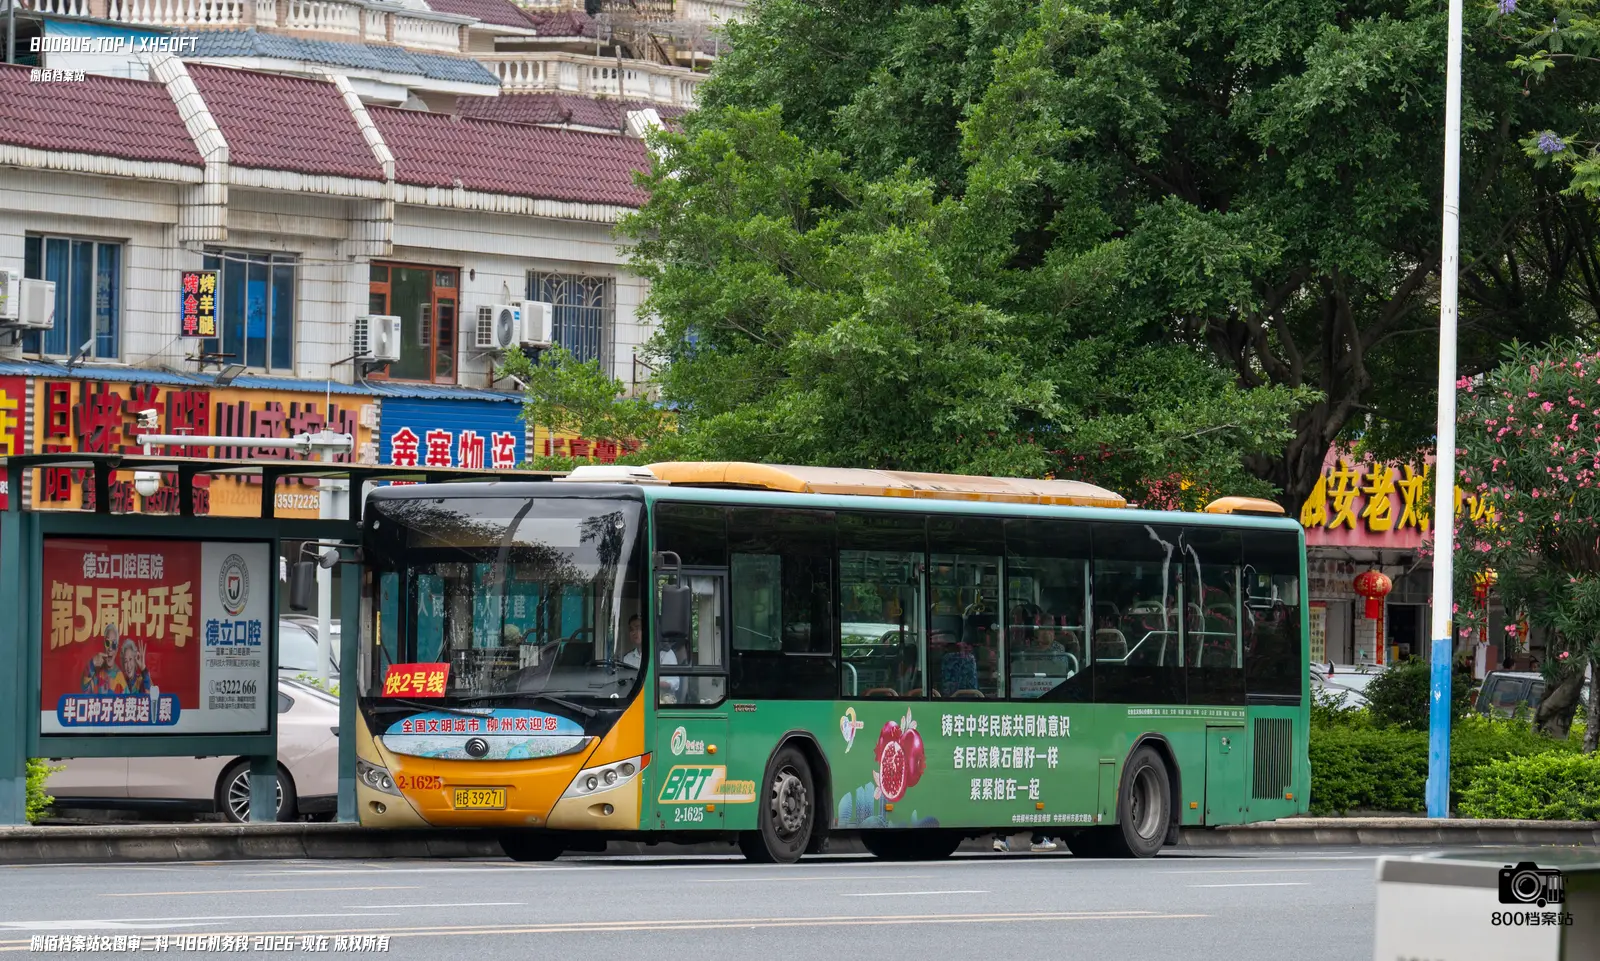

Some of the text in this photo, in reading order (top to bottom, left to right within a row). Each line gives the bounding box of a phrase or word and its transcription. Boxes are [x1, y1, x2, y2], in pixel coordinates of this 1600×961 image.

[183, 273, 199, 335] 烤全羊
[199, 273, 215, 335] 烤羊腿
[274, 492, 321, 509] 135972225
[83, 552, 164, 580] 德立口腔医院
[51, 580, 193, 650] 第5届种牙季
[205, 618, 262, 647] 德立口腔
[385, 670, 446, 696] 快2号线
[402, 715, 558, 734] 全国文明城市 柳州欢迎您
[941, 714, 1071, 738] 铸牢中华民族共同体意识
[953, 746, 1059, 769] 各民族像石榴籽一样
[398, 775, 442, 790] 2-1625
[663, 768, 715, 801] BRT
[970, 778, 1041, 801] 紧紧抱在一起
